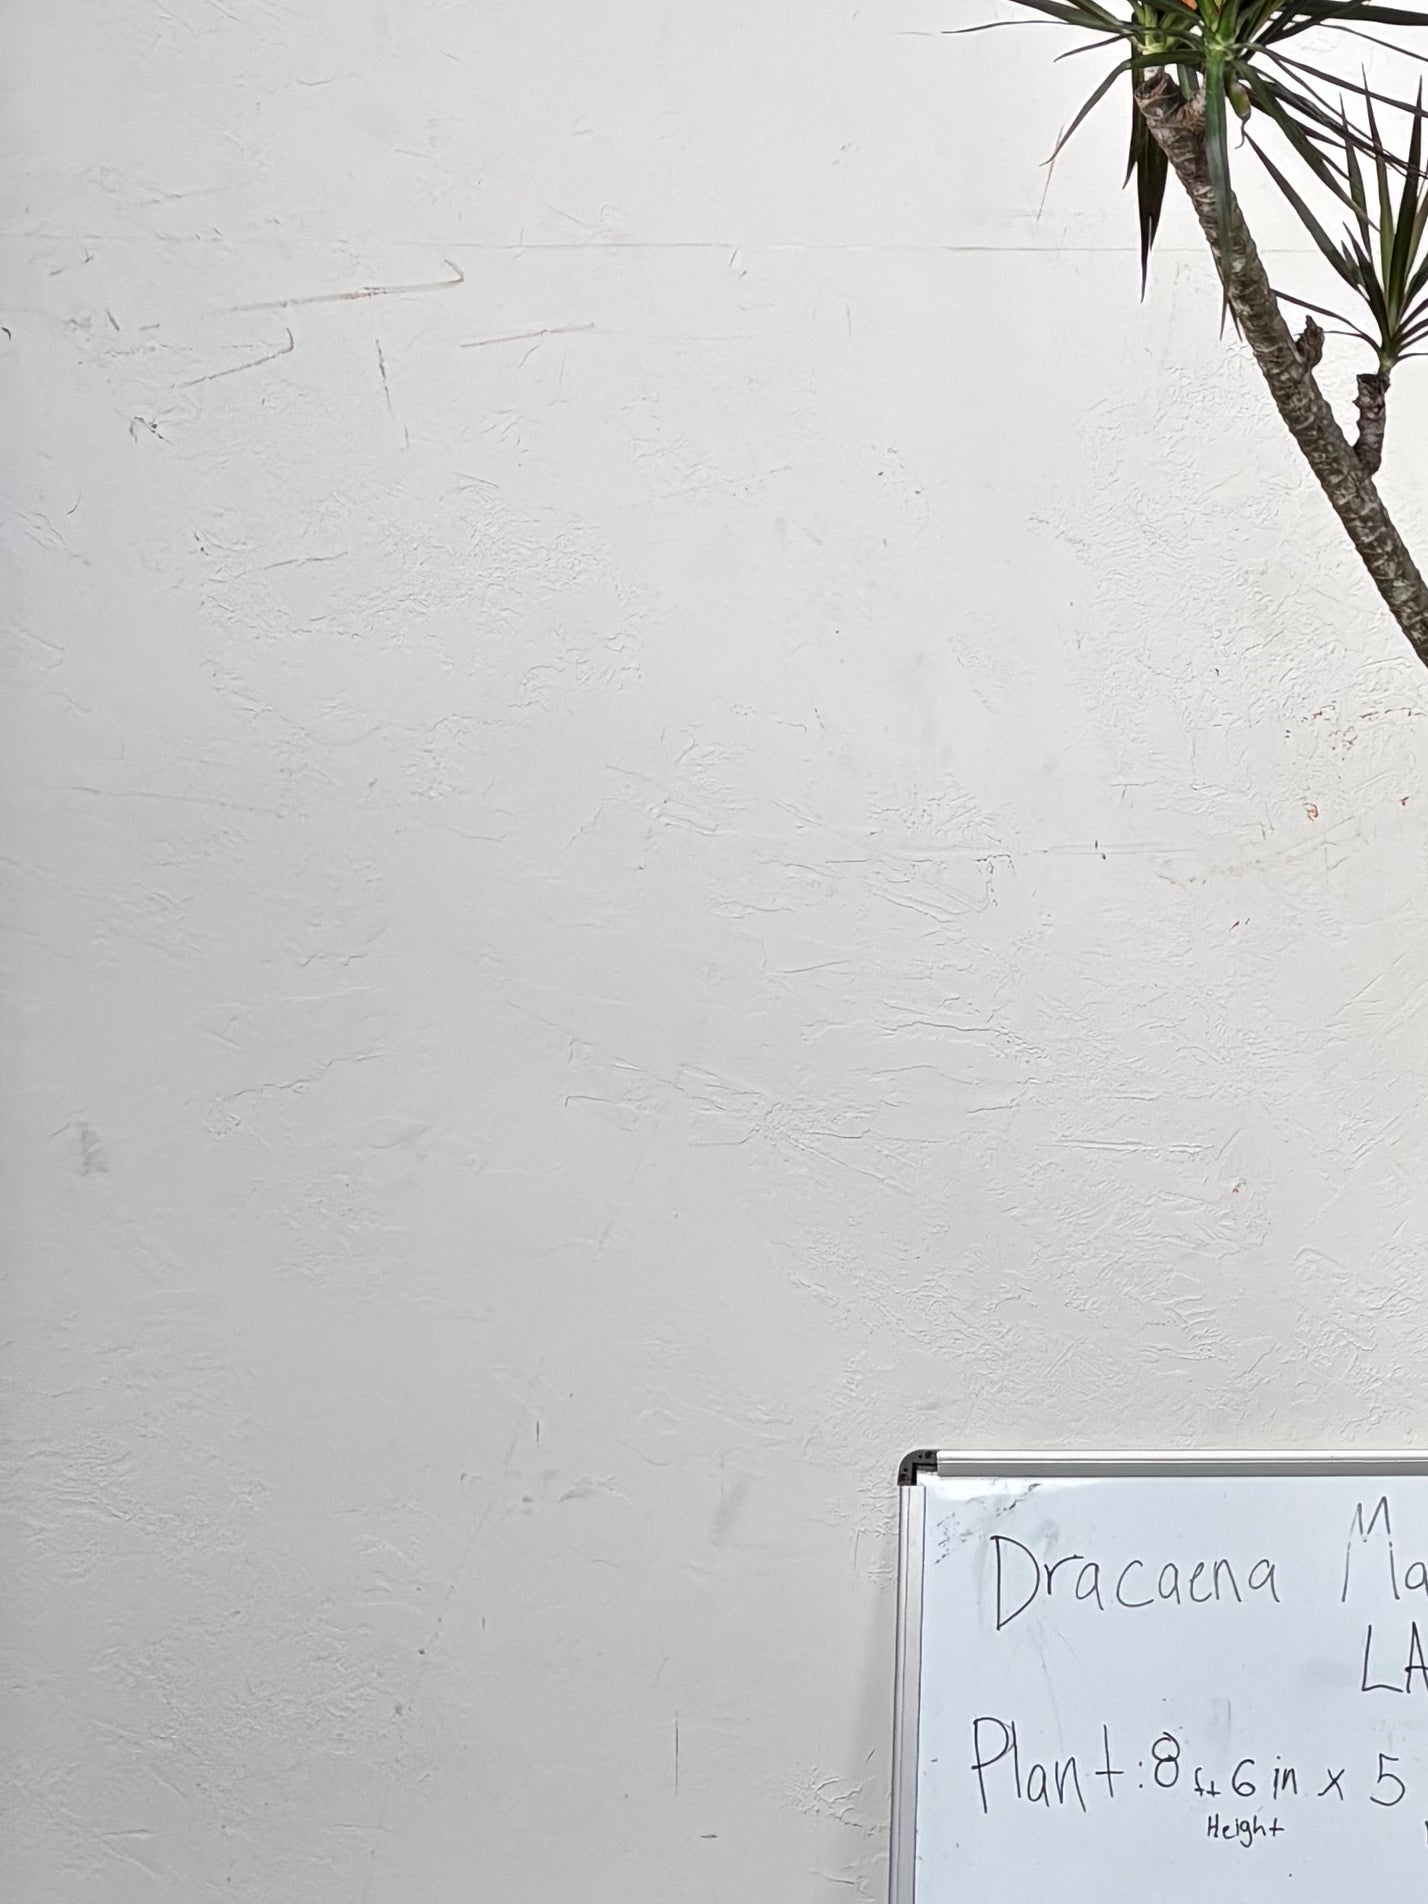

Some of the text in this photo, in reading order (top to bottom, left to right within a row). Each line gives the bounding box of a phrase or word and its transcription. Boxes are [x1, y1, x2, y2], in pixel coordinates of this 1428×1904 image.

[989, 1535, 1280, 1630] Dracaena
[971, 1717, 1143, 1814] Plant:
[1231, 1759, 1257, 1797] 6
[1273, 1756, 1298, 1800] in
[1370, 1753, 1406, 1806] 5
[1207, 1813, 1285, 1848] Height
